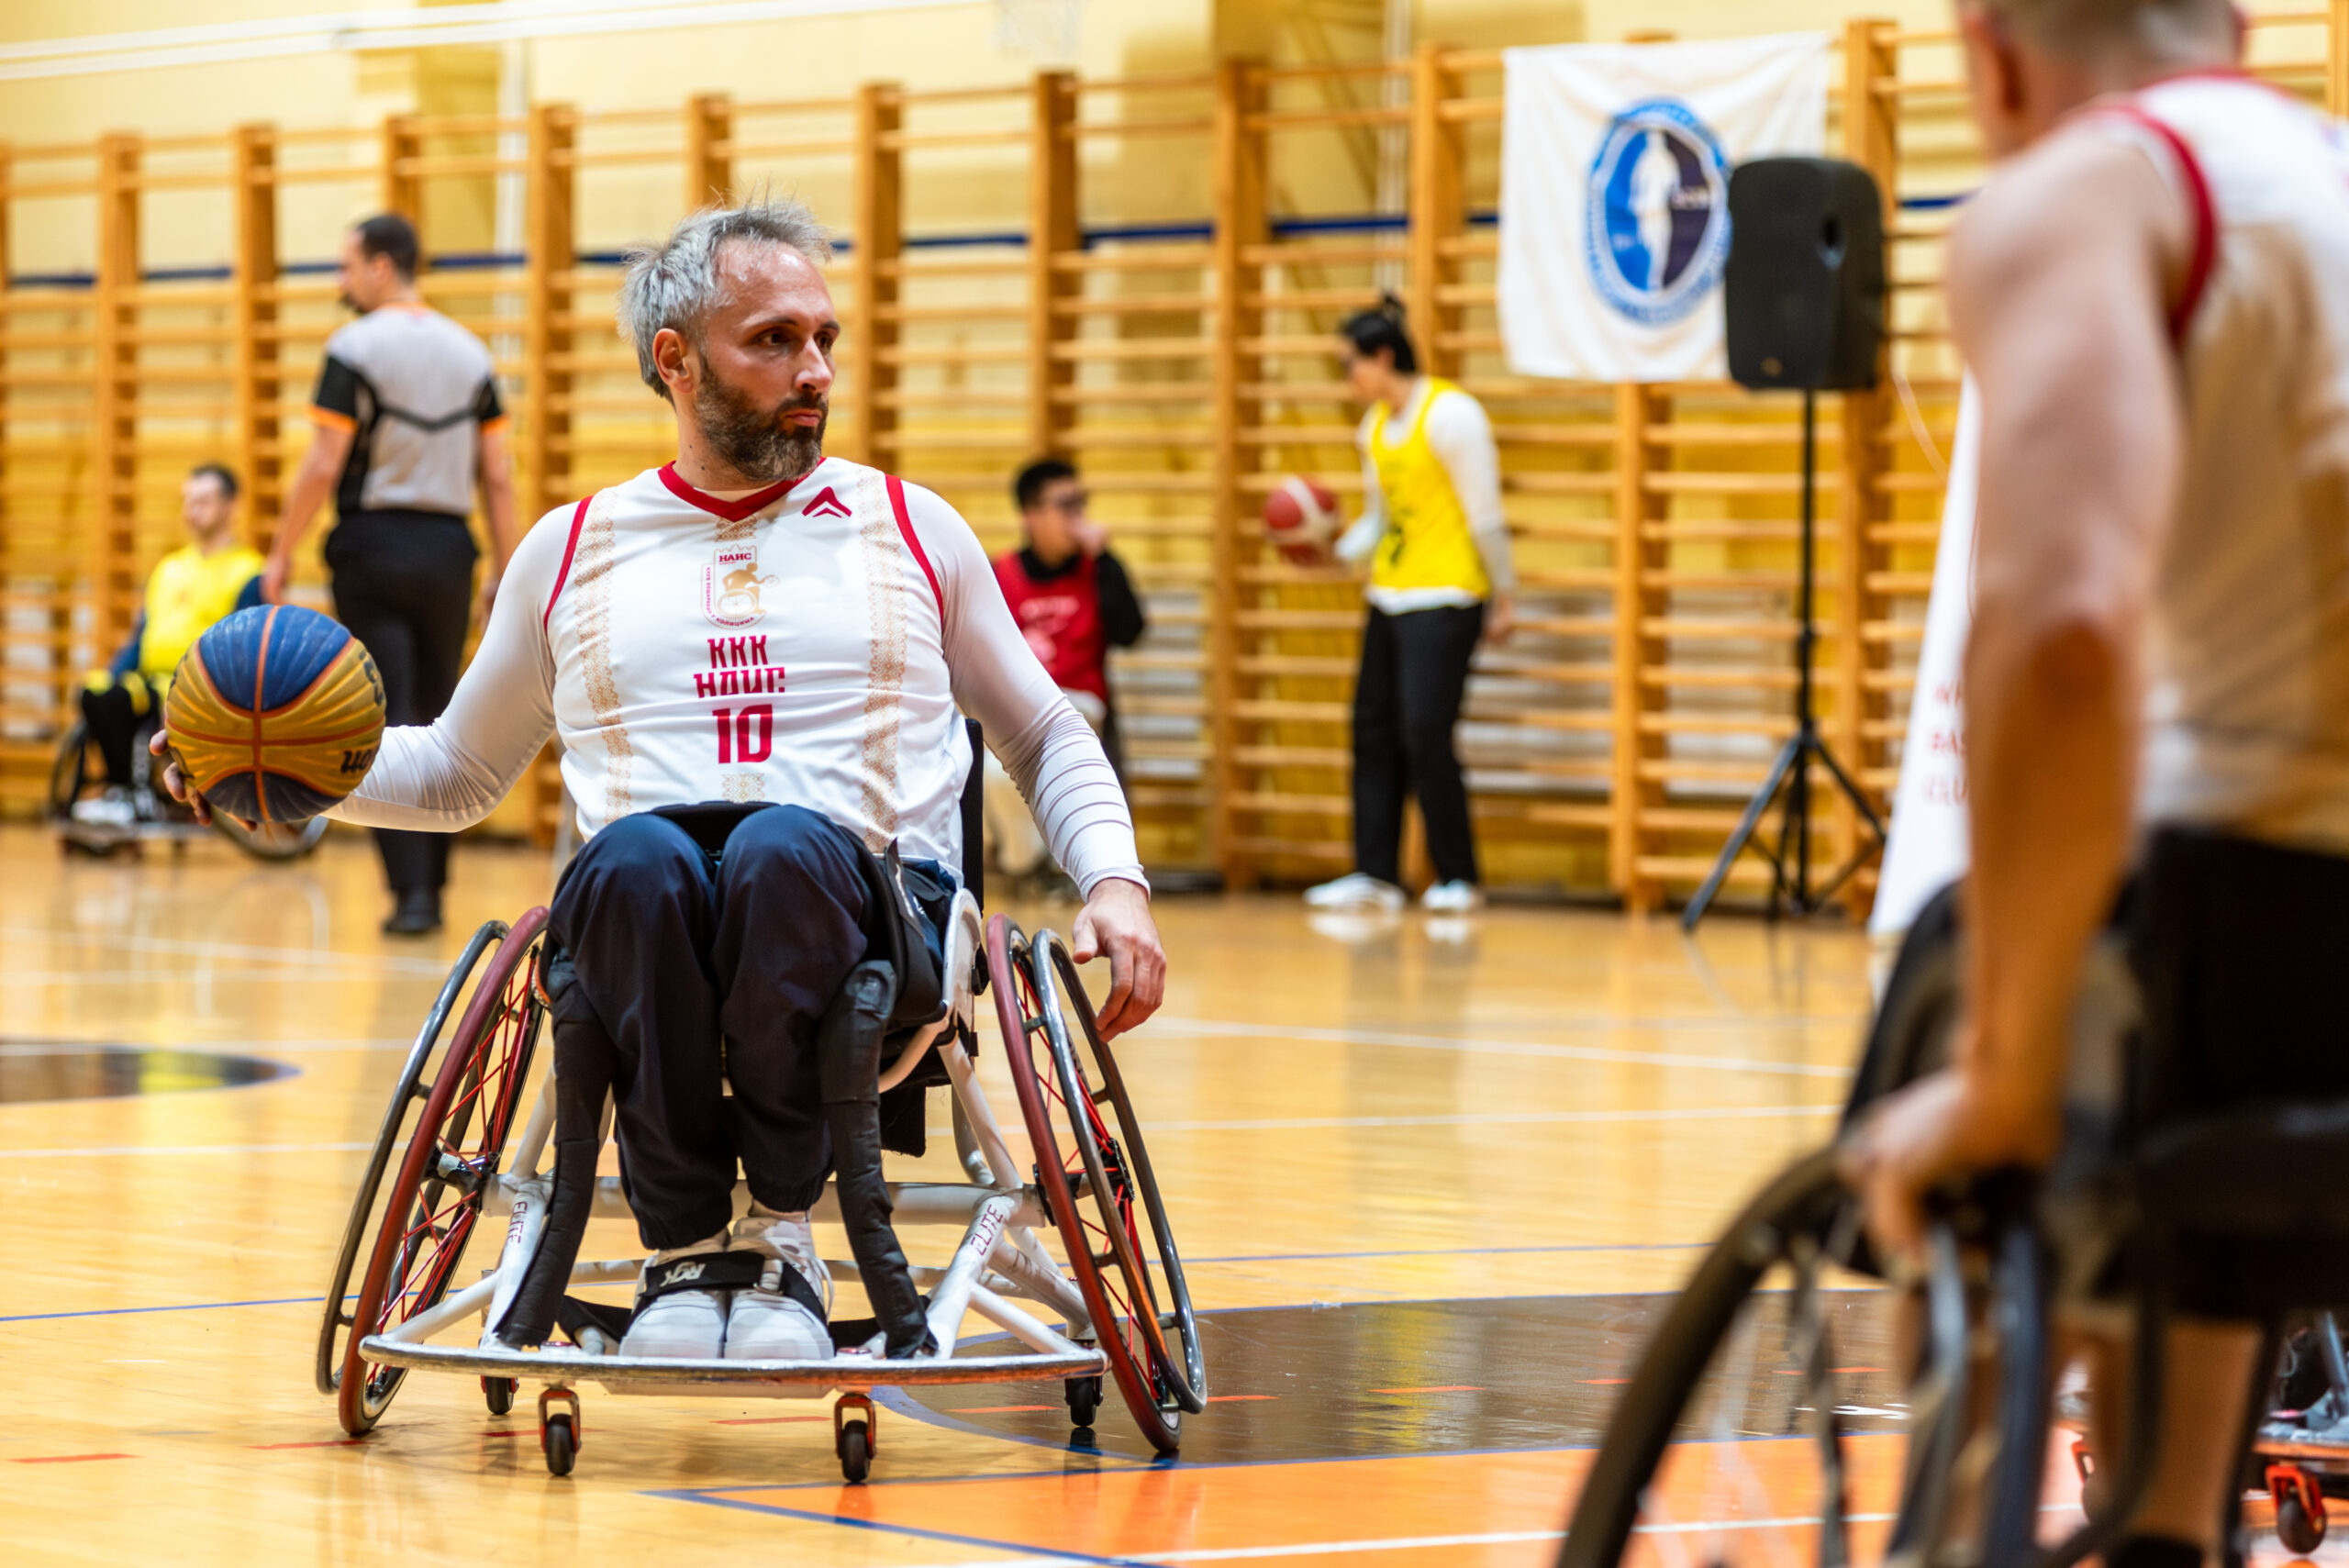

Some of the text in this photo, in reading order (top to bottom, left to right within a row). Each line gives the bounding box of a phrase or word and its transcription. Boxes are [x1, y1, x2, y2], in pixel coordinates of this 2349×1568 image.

[712, 704, 773, 763] 10
[507, 1201, 528, 1244] ELITE
[971, 1204, 1003, 1255] ELITE
